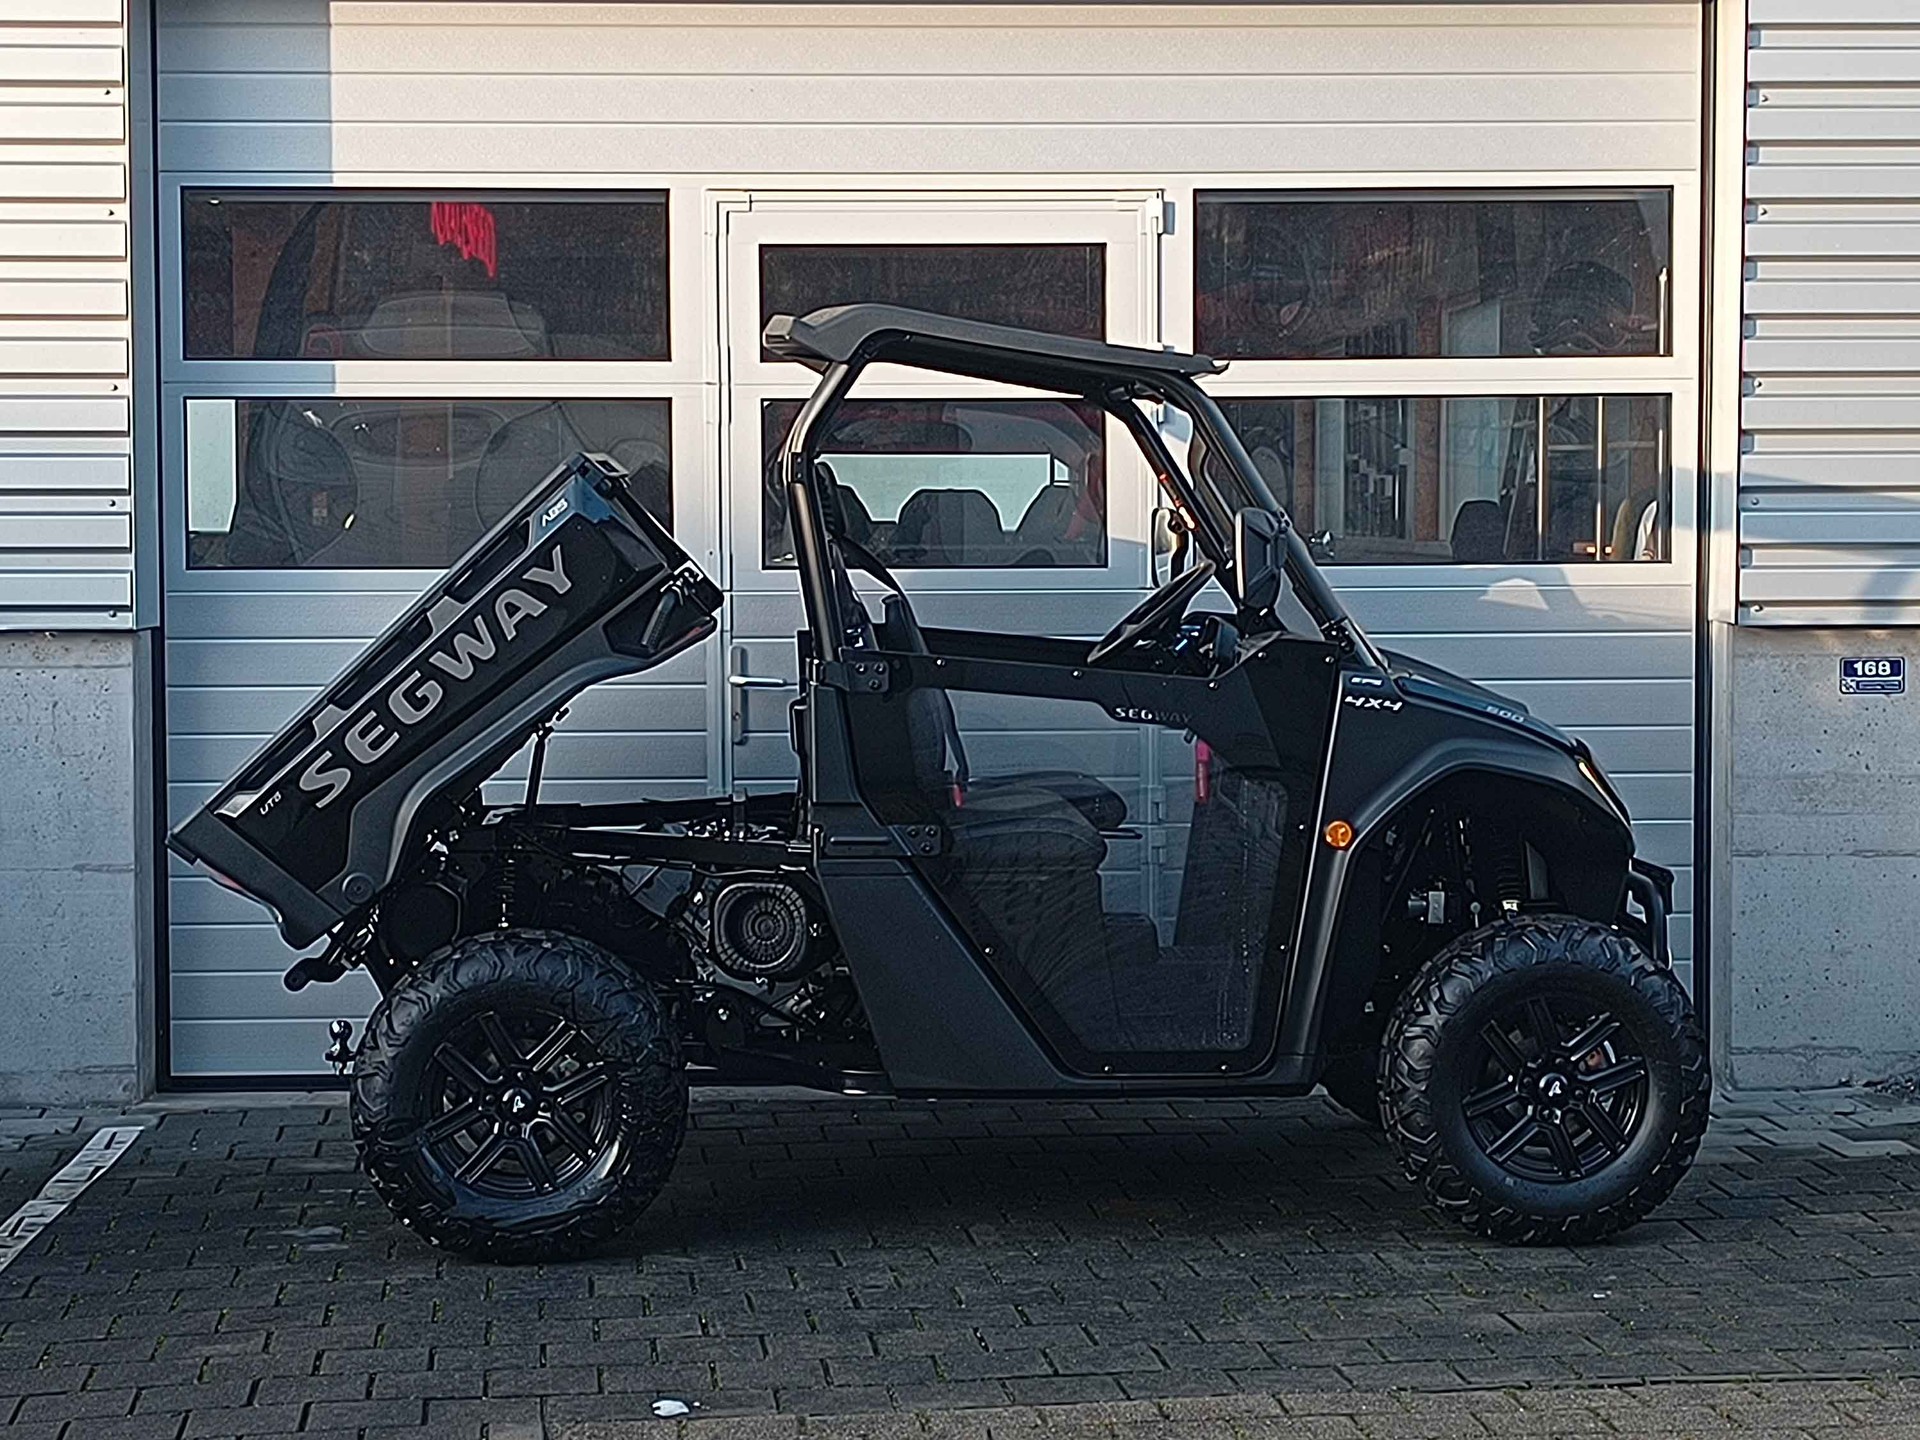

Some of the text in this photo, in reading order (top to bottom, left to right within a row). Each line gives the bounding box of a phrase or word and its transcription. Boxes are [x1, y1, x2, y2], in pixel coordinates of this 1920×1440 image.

[299, 544, 572, 809] SEGWAY
[1853, 661, 1891, 676] 168
[1115, 707, 1192, 724] SEGWAY
